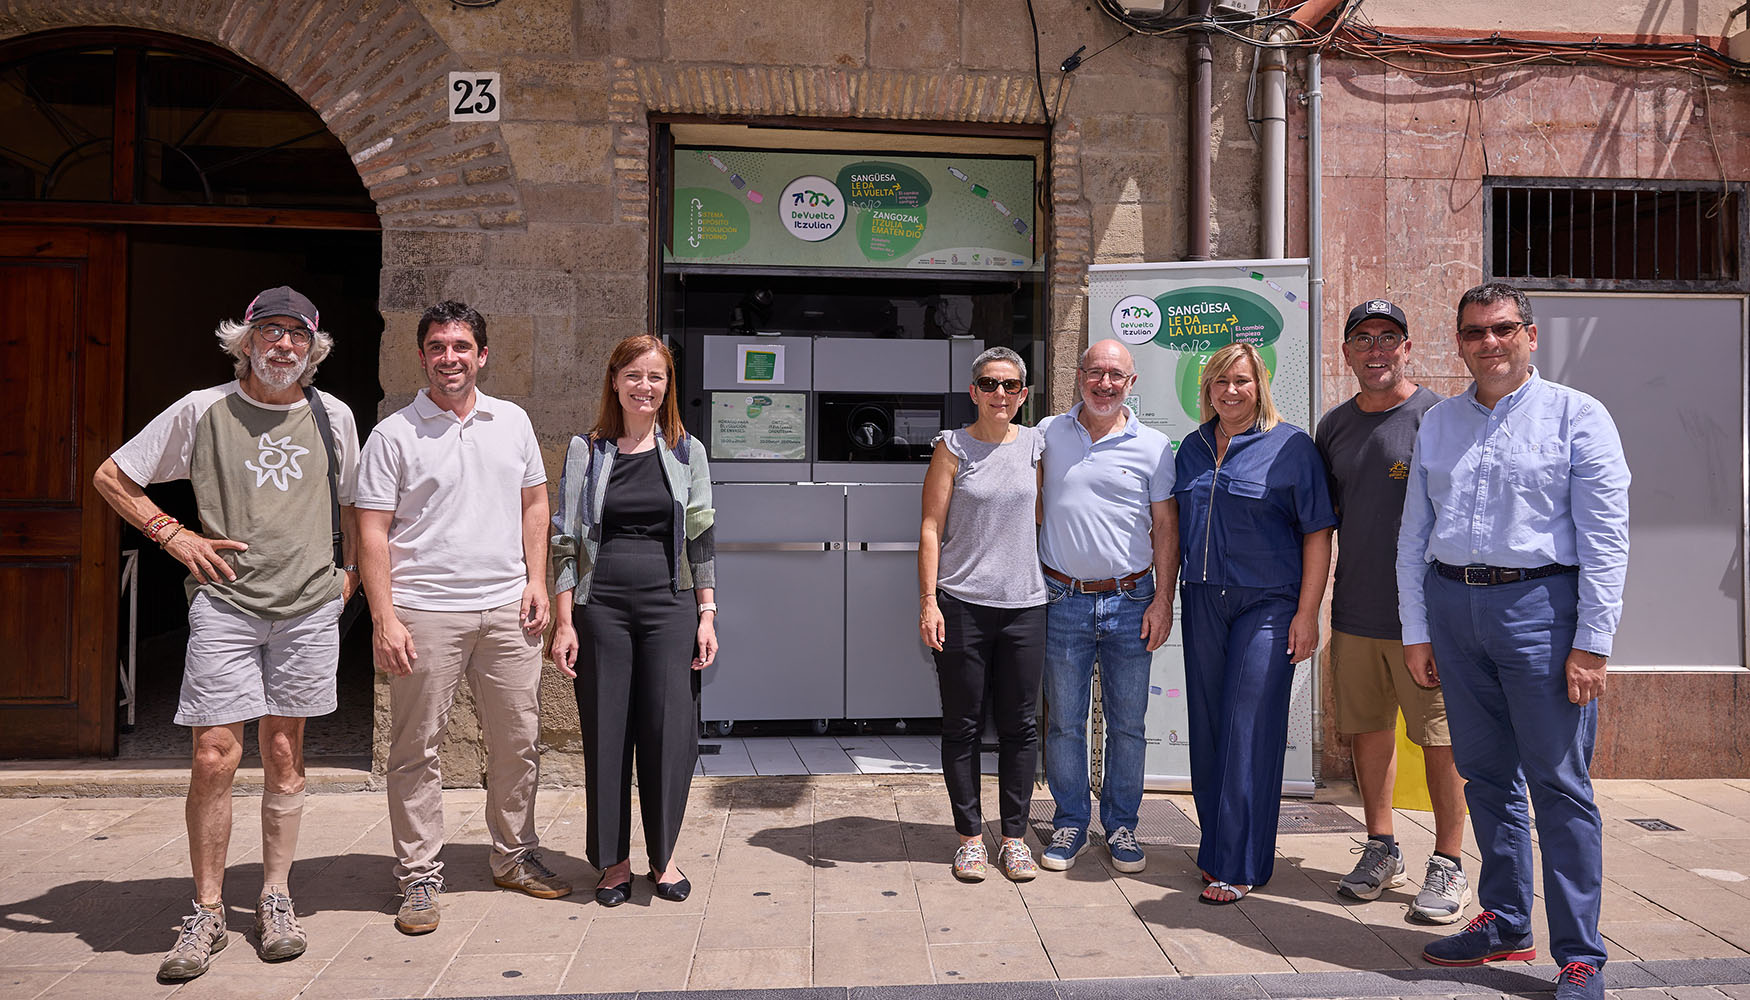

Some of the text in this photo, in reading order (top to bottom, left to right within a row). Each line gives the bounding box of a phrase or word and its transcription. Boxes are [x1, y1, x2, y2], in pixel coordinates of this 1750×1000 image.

[453, 79, 497, 115] 23
[850, 172, 897, 182] SANGÜESA
[851, 182, 875, 190] LE DA
[852, 188, 895, 198] LA VUELTA
[791, 211, 836, 221] DeVuelta
[872, 211, 920, 224] ZANGOZAK
[794, 220, 832, 230] Itzulian
[872, 219, 904, 229] ITZULIA
[871, 226, 922, 239] EMATEN DIO
[1167, 302, 1232, 317] SANGÜESA
[1168, 315, 1201, 327] LE DA
[1169, 324, 1229, 337] LA VUELTA
[1235, 331, 1261, 339] empieza
